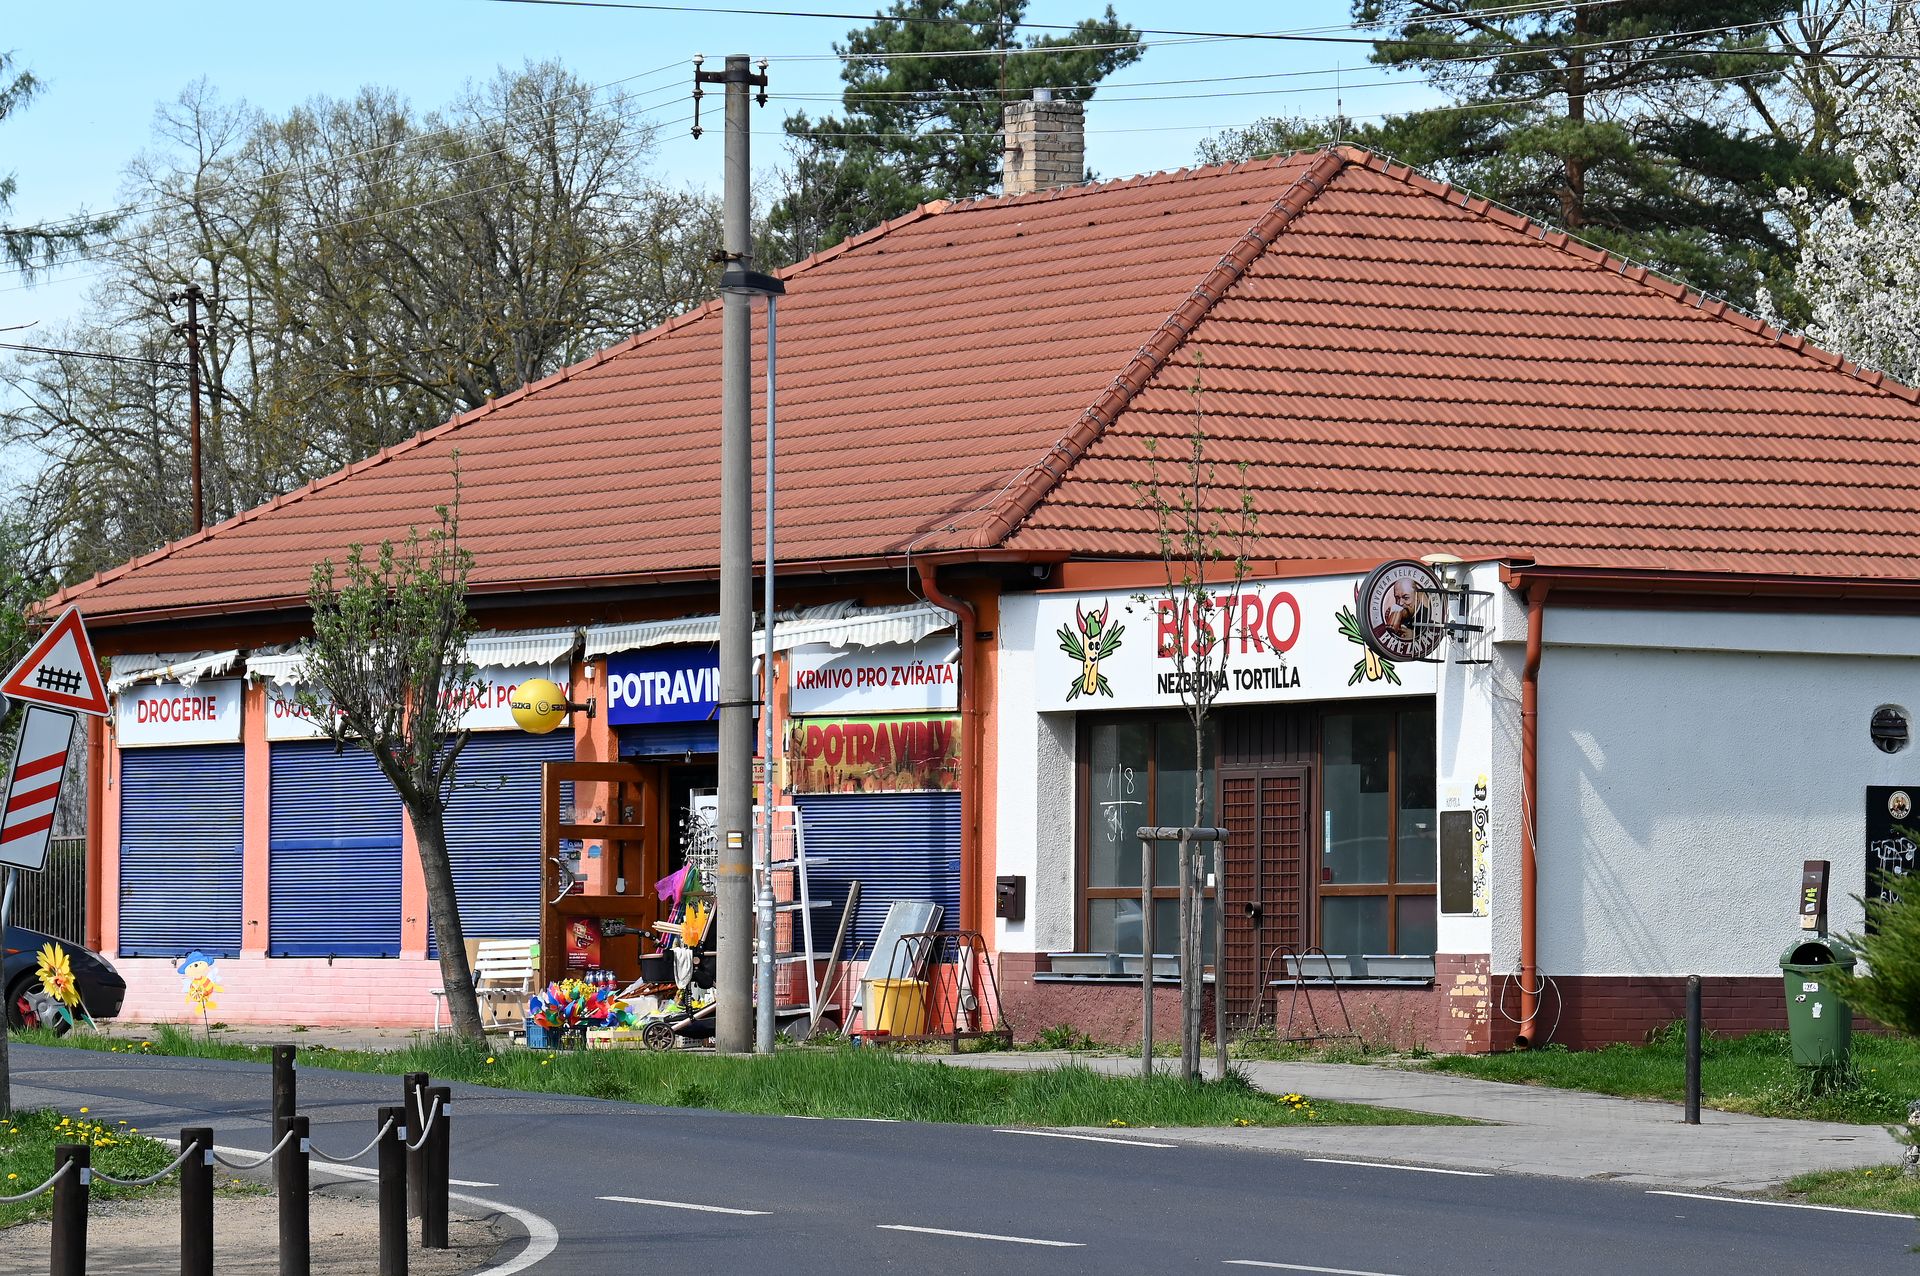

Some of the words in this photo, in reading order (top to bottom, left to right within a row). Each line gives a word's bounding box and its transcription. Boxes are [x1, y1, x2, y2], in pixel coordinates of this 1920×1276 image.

[1372, 575, 1392, 611] PIVOVAR
[1157, 592, 1301, 659] BISTRO
[796, 668, 853, 690] KRMIVO
[857, 665, 888, 688] PRO
[891, 660, 954, 687] ZVÍŘATA
[1233, 666, 1301, 691] TORTILLA
[137, 696, 217, 724] DROGERIE
[805, 720, 954, 770] POTRAVINY
